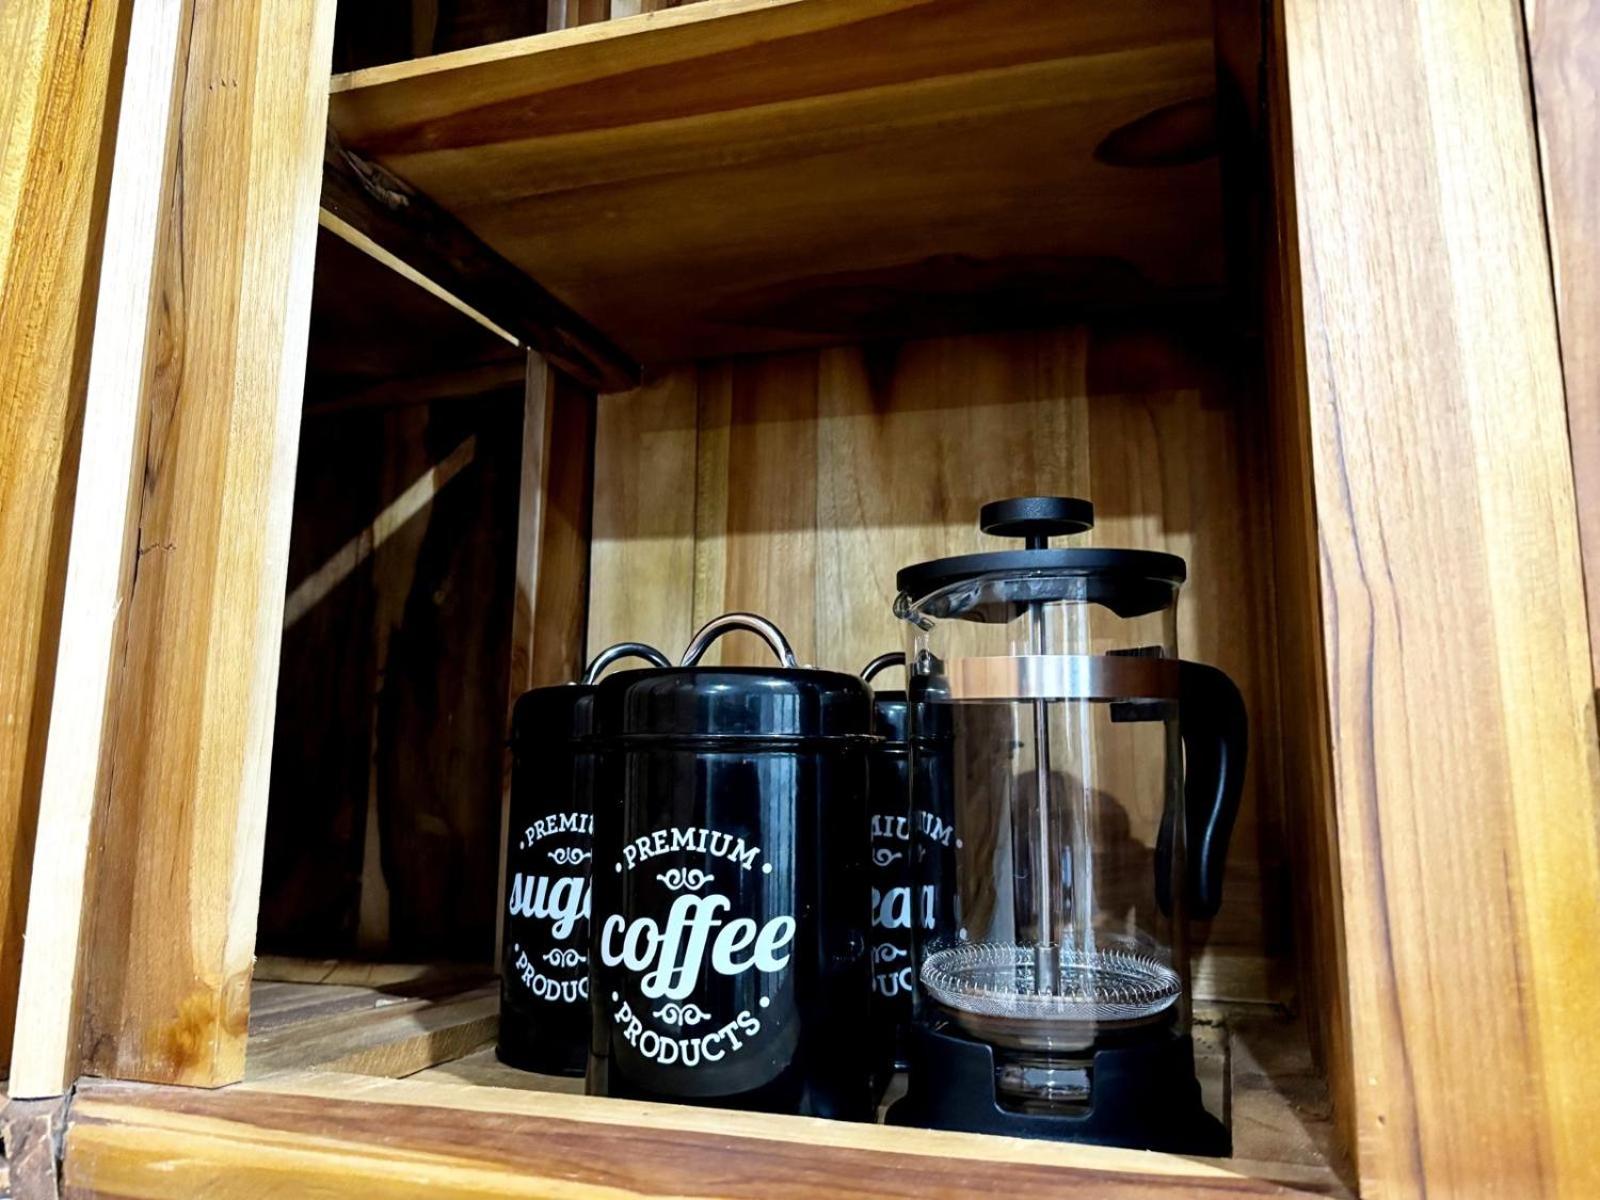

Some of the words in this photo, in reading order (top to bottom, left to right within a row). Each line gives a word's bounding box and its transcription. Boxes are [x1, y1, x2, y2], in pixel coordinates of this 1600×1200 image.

[623, 827, 761, 871] PREMIUM
[601, 894, 796, 1000] coffee
[872, 967, 913, 997] UC
[613, 1001, 761, 1067] PRODUCTS
